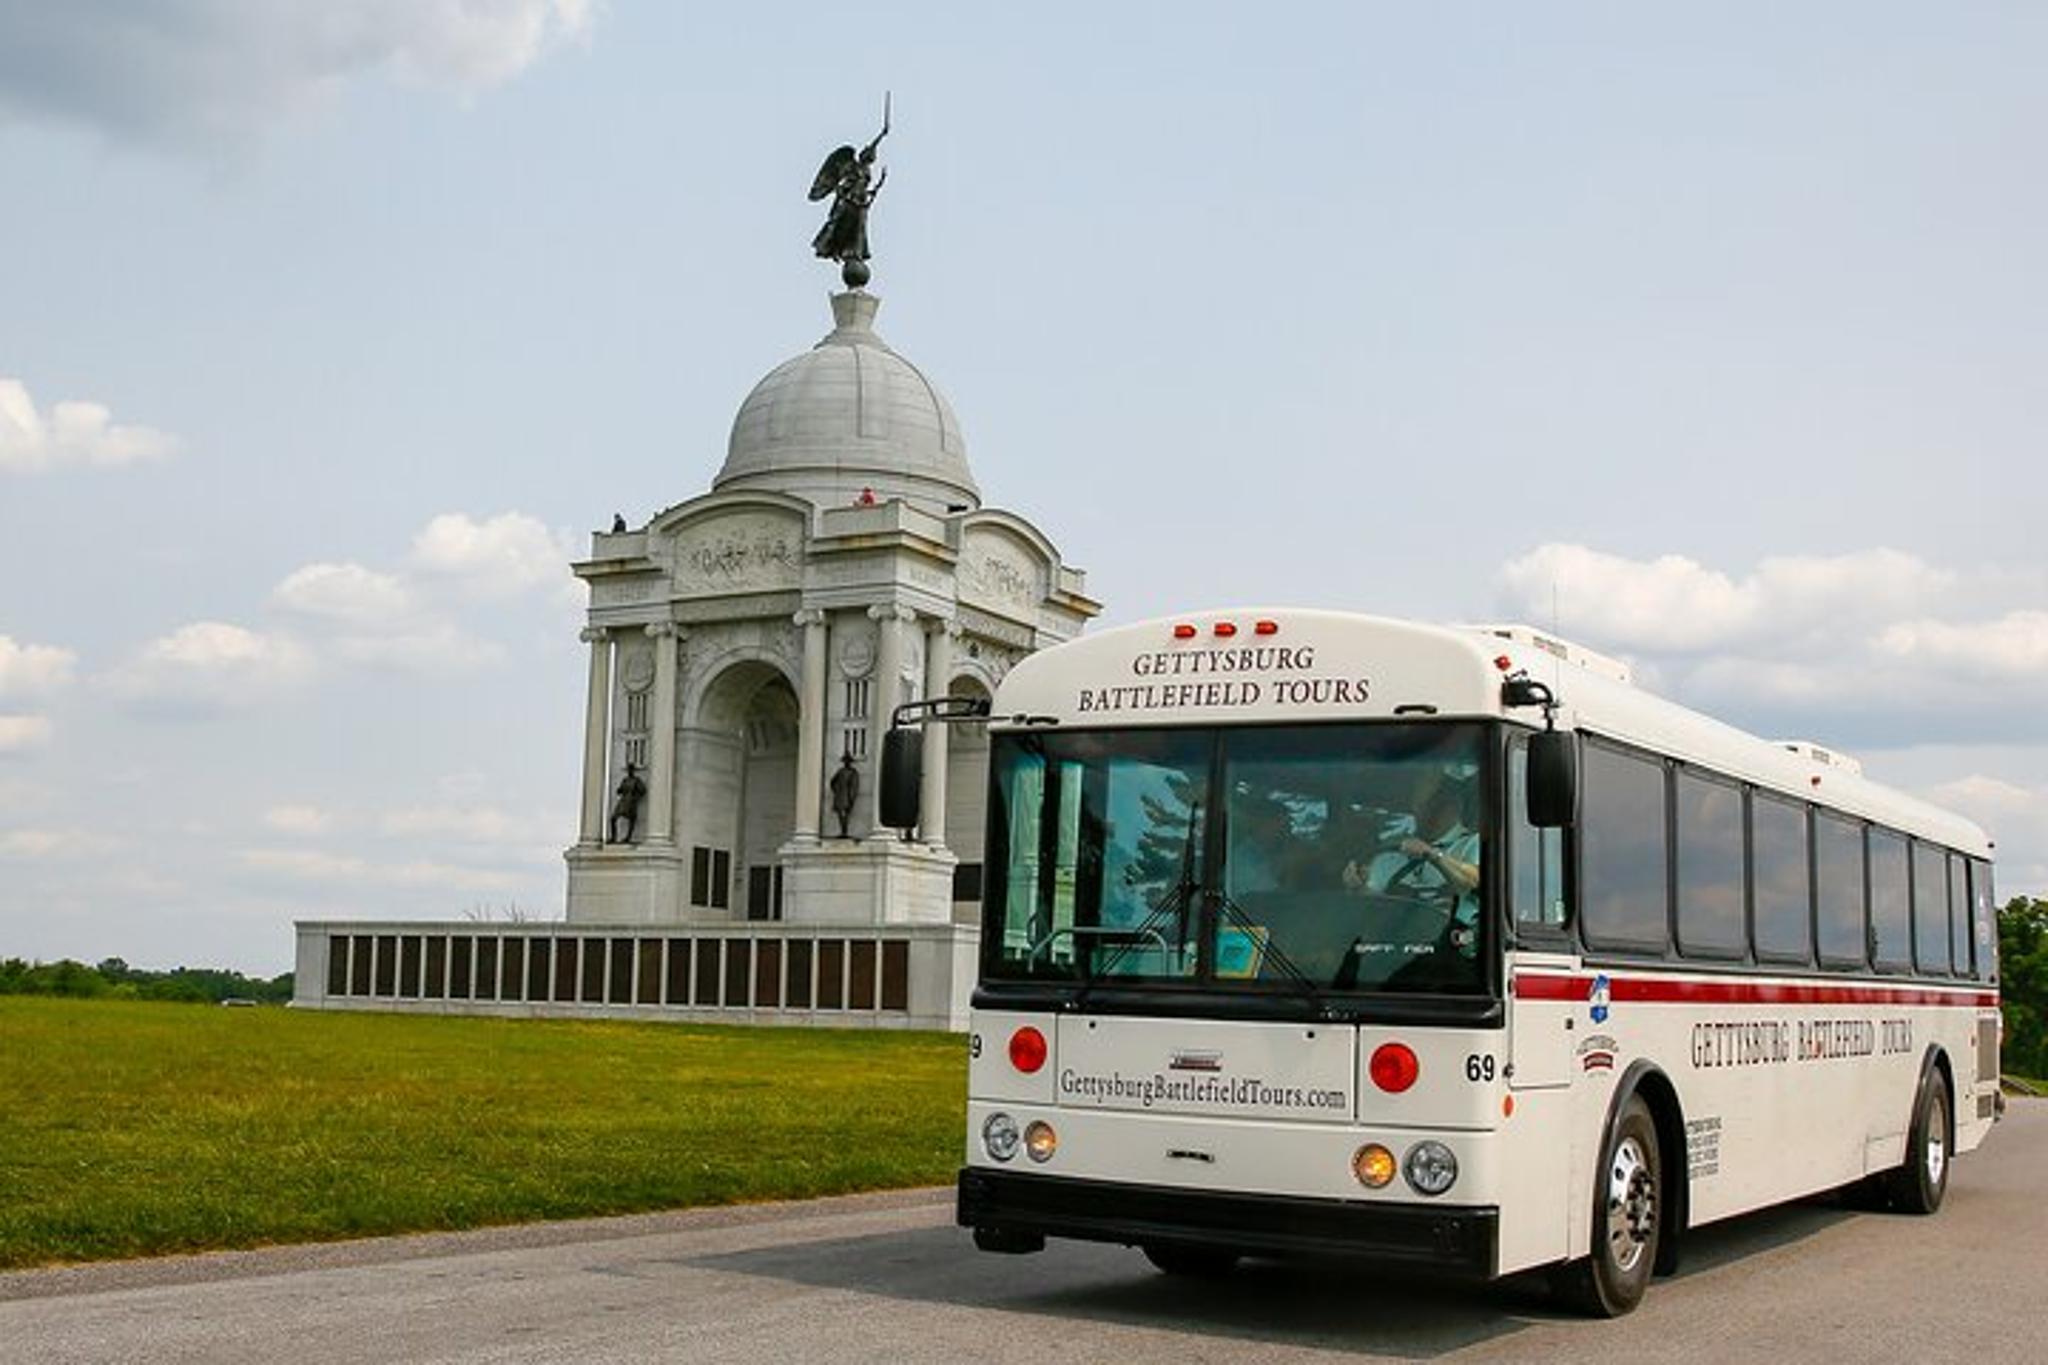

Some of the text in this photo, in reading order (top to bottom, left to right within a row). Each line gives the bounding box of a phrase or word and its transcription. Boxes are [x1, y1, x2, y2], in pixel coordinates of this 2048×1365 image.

[1133, 647, 1314, 676] GETTYSBURG
[1078, 679, 1370, 712] BATTLEFIELD TOURS
[1466, 1054, 1494, 1082] 69
[1060, 1068, 1346, 1109] GettysburgBattlefieldTours.com
